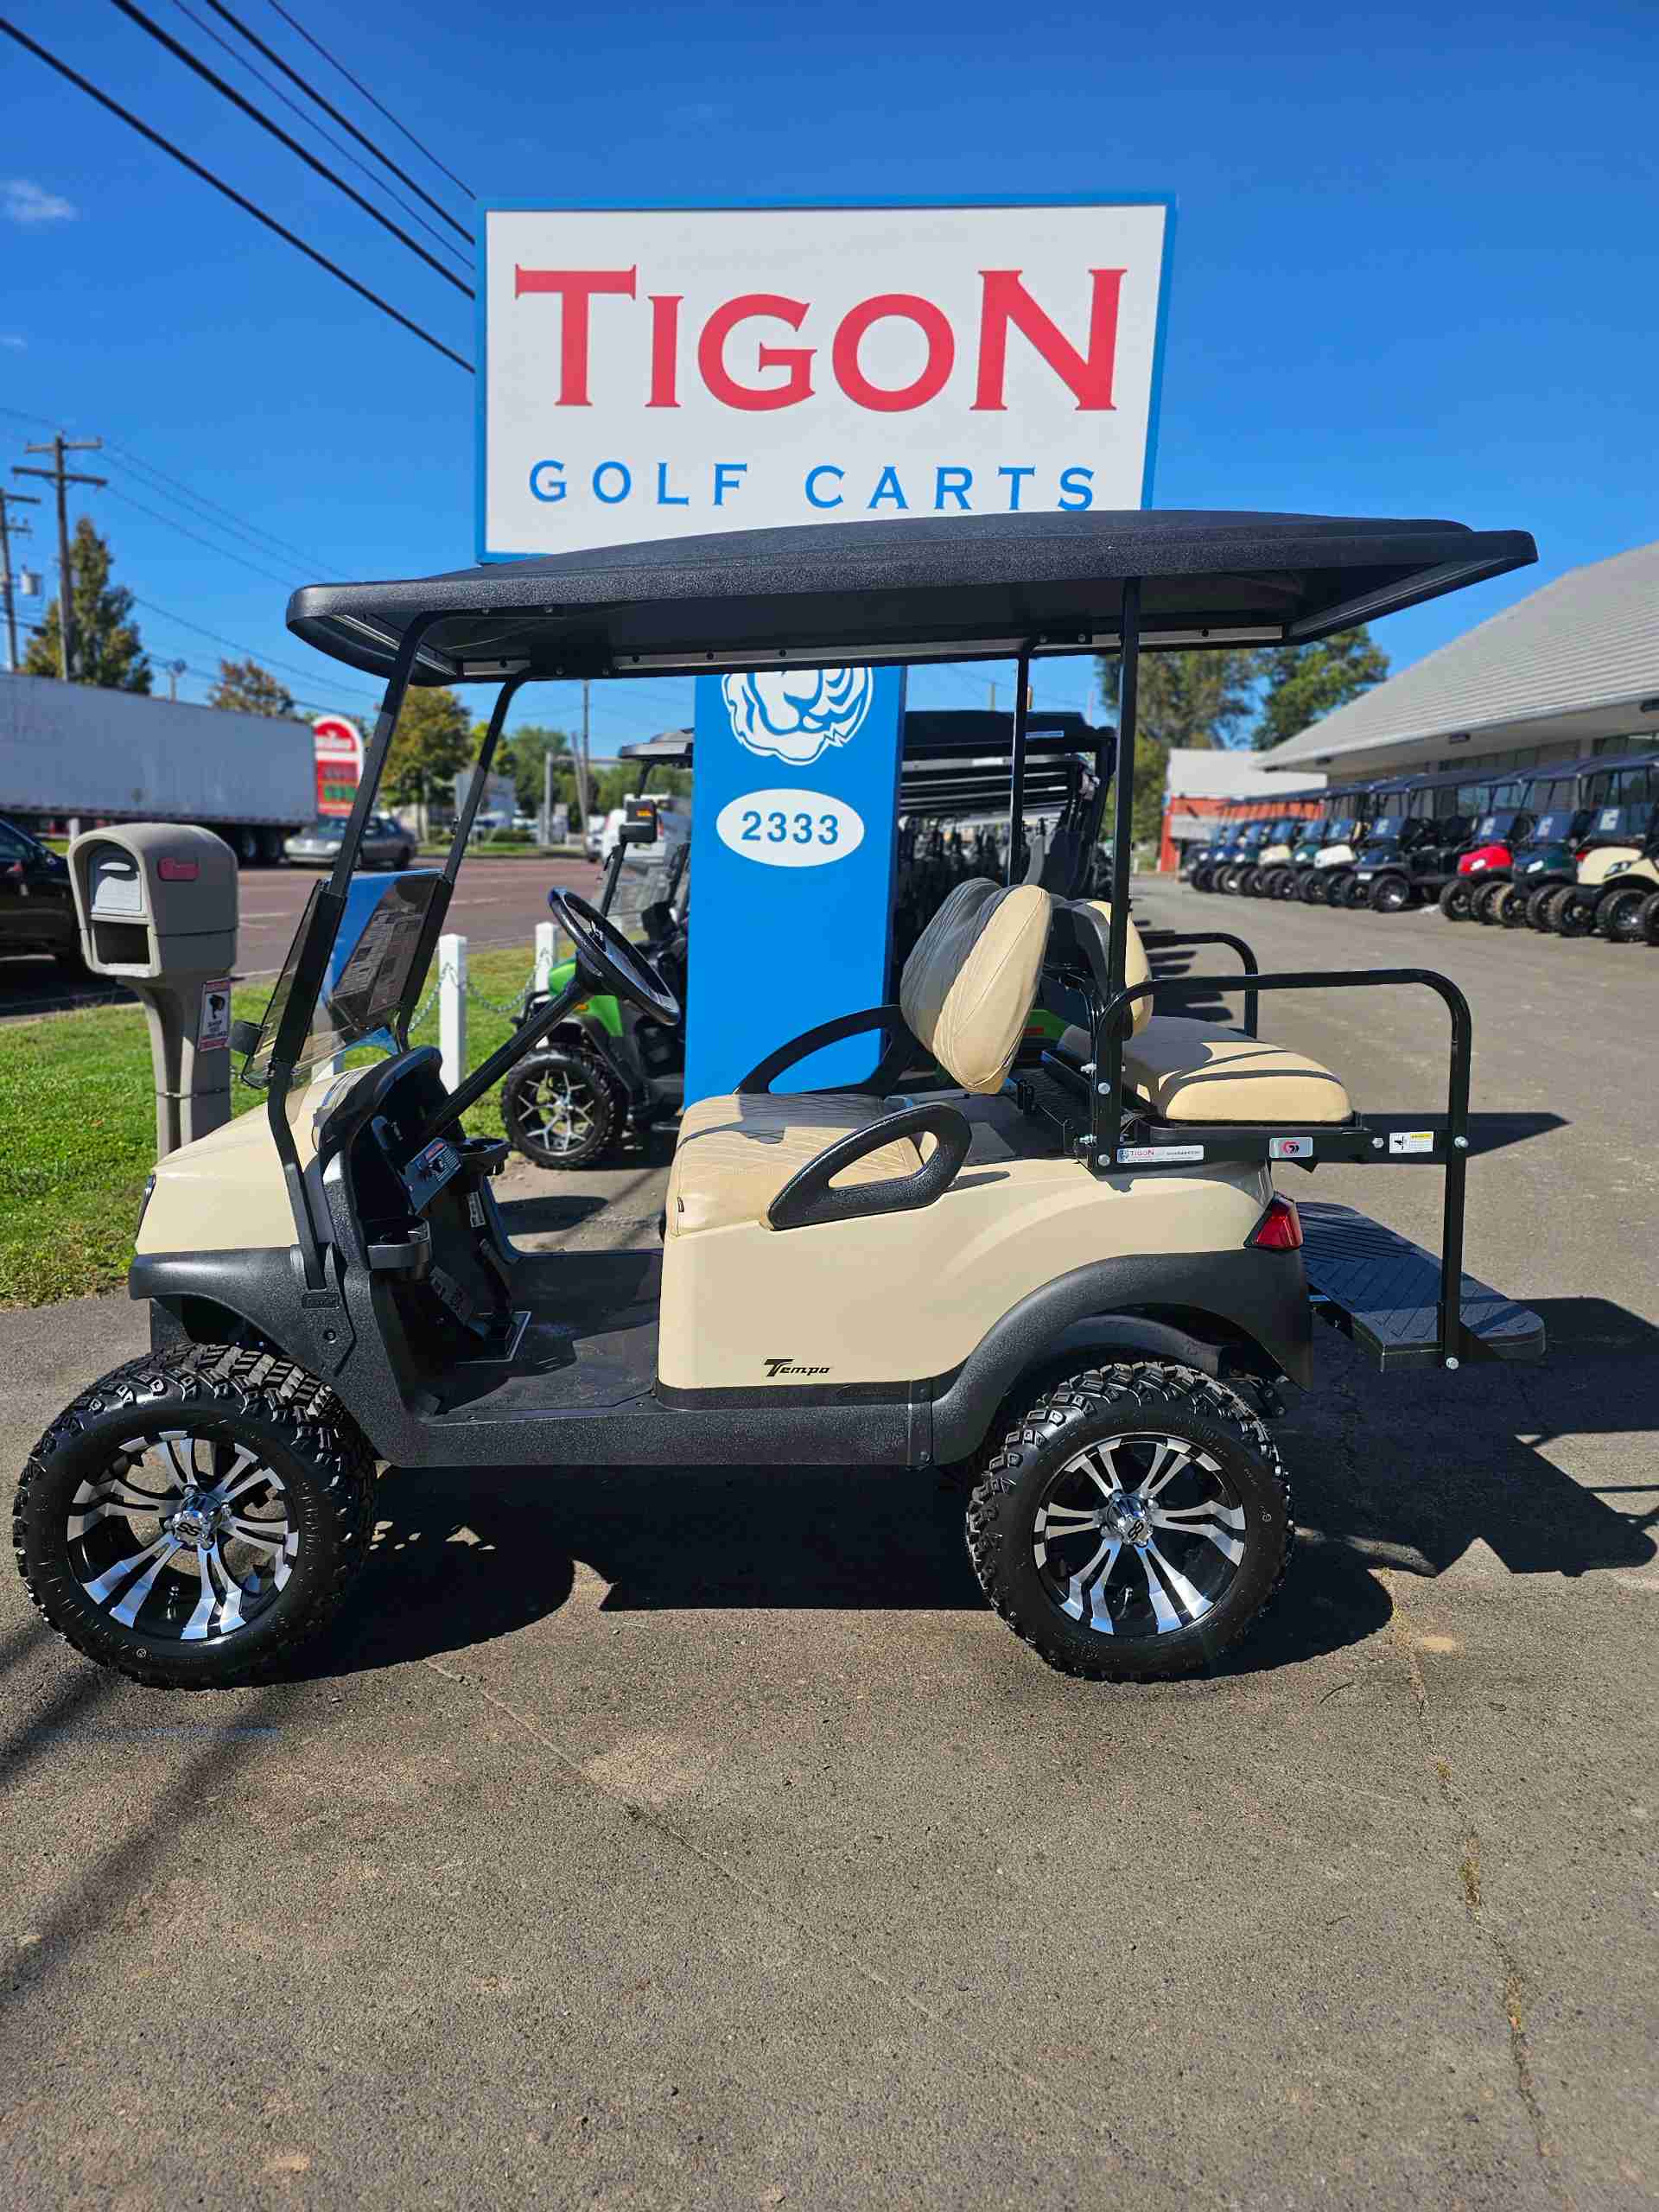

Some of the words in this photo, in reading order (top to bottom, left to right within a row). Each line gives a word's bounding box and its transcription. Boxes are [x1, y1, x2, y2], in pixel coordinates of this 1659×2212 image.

[515, 264, 1127, 412] TIGON
[529, 460, 748, 507] GOLF
[804, 465, 1095, 512] CARTS
[741, 810, 838, 845] 2333
[764, 1358, 831, 1377] Tempo
